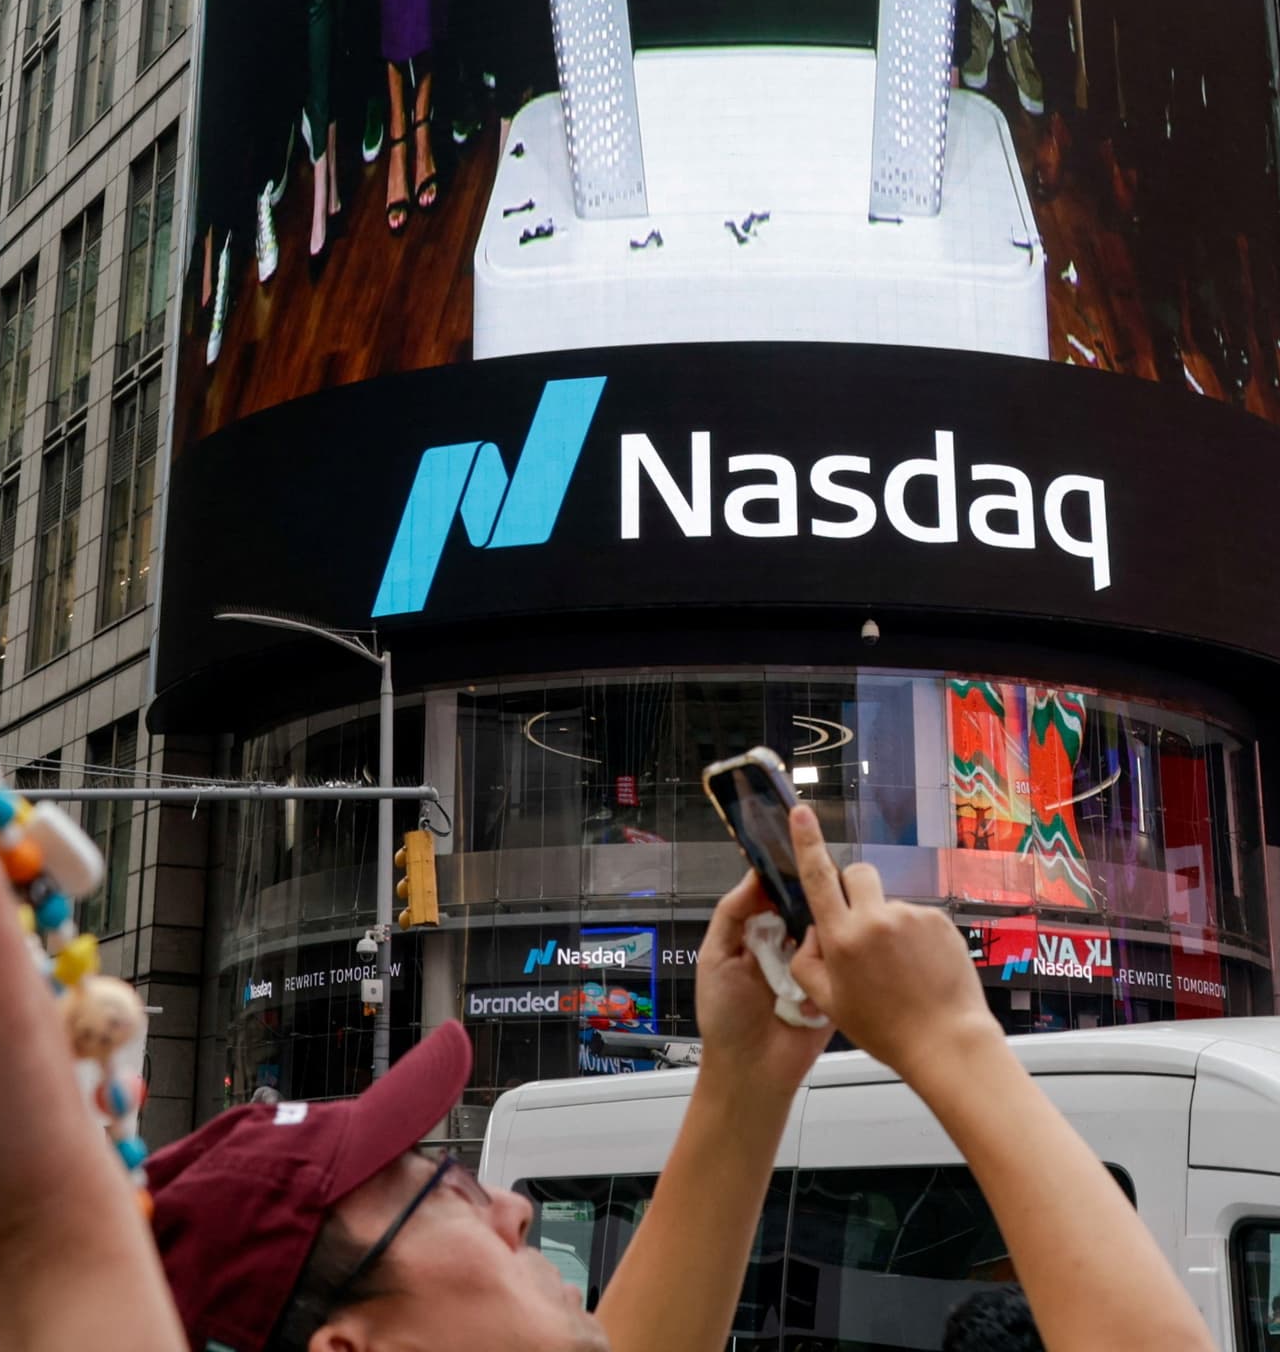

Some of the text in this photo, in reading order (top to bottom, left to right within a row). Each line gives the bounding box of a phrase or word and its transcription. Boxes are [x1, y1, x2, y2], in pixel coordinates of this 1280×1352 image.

[621, 429, 1110, 591] Nasdaq
[557, 947, 626, 968] Nasdaq
[285, 971, 325, 992] REWRITE
[330, 962, 402, 984] TOMORRW
[1034, 957, 1093, 983] Nasdaq
[1120, 968, 1173, 990] REWRITE
[470, 989, 579, 1015] brandedci
